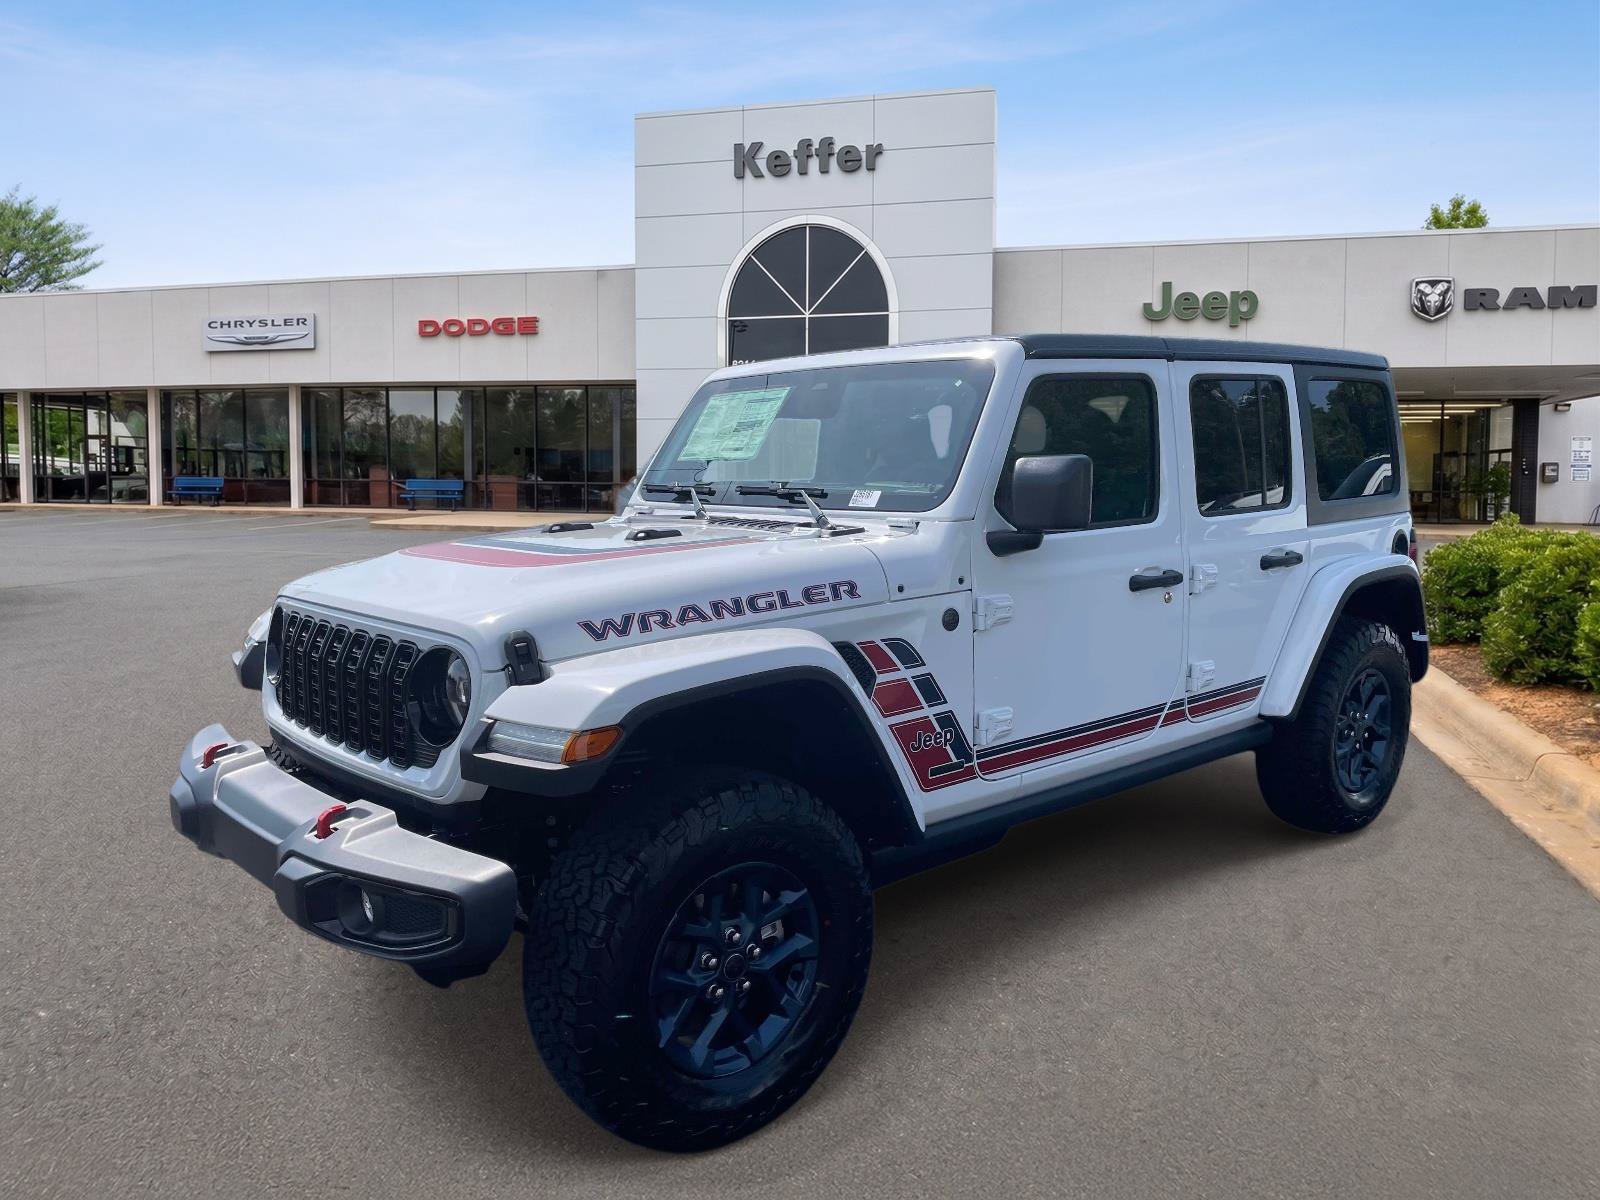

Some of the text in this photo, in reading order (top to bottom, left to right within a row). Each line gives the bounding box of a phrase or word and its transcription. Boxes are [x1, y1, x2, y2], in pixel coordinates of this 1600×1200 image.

[733, 136, 884, 179] Keffer
[1142, 281, 1259, 327] Jeep
[1464, 284, 1598, 311] RAM
[207, 317, 308, 329] CHRYSLER
[418, 316, 539, 337] DODGE
[577, 579, 861, 642] WRANGLER
[909, 727, 955, 753] Jeep
